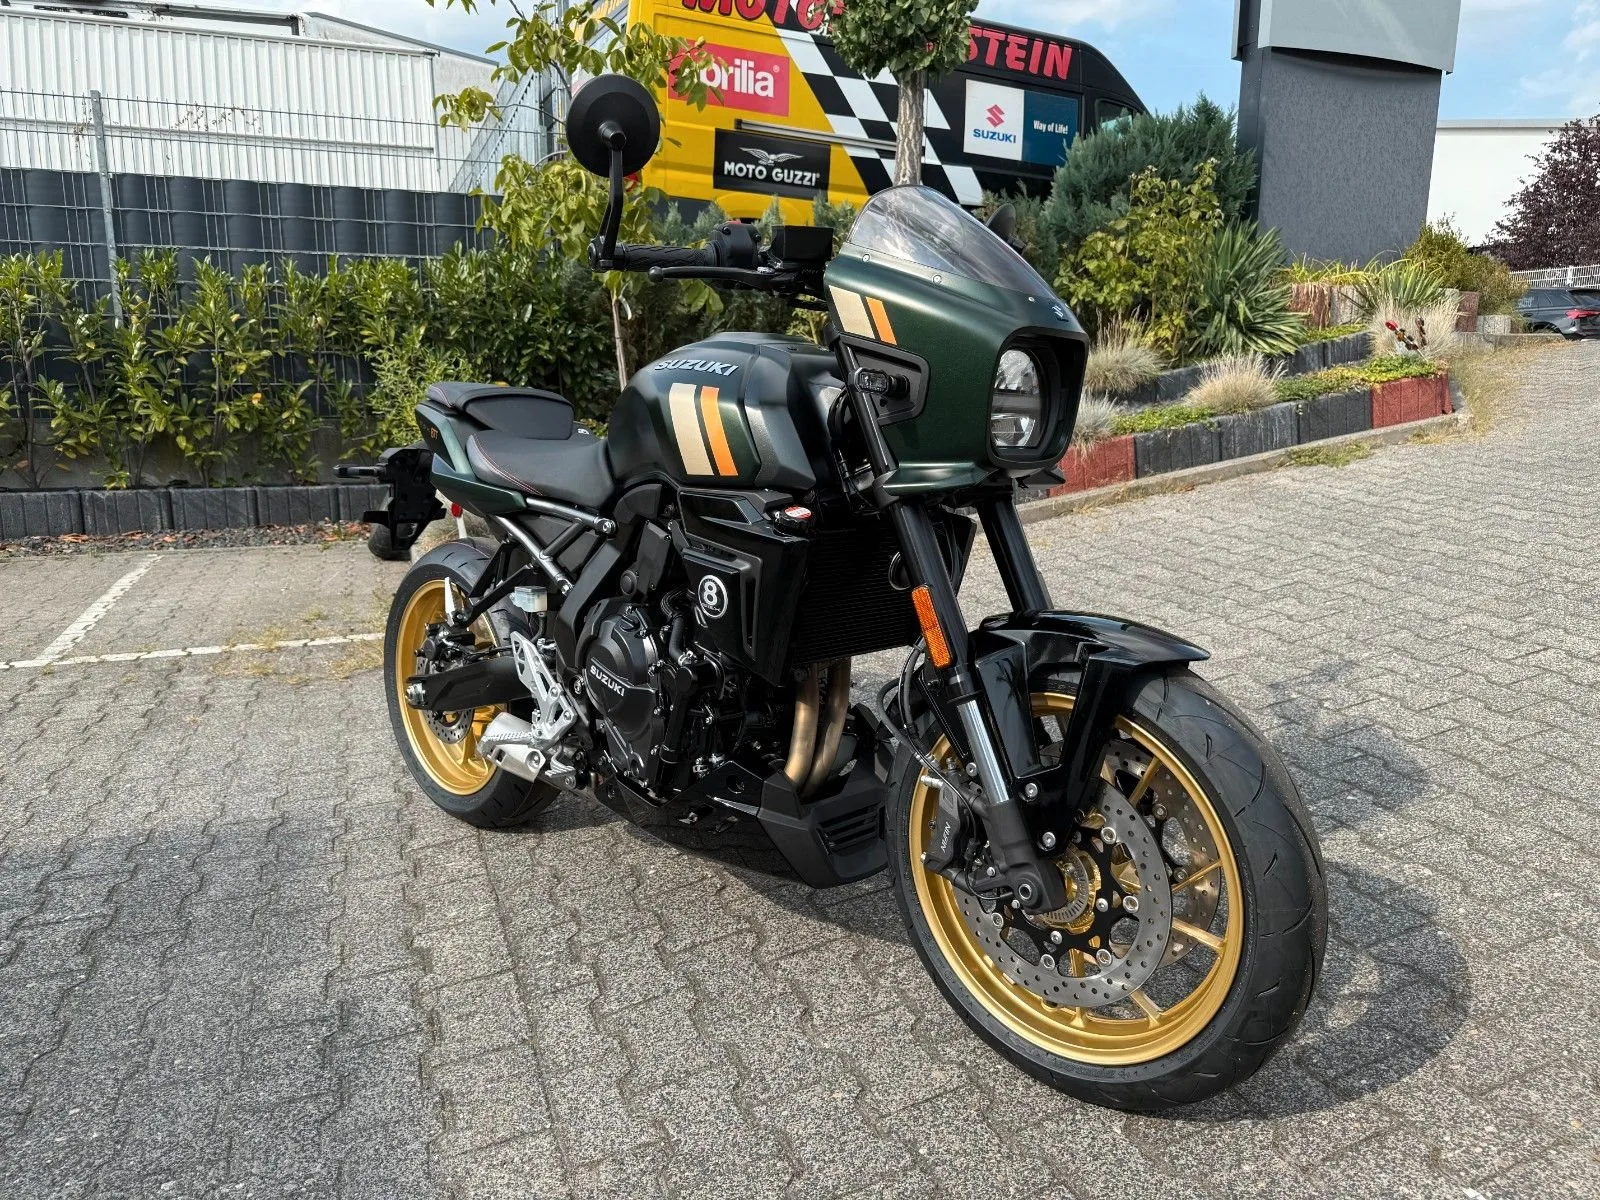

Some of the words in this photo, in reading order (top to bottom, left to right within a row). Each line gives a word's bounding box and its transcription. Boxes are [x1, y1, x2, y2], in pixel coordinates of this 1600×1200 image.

[682, 58, 774, 98] prilia
[973, 128, 1017, 144] SUZUKI
[1033, 120, 1047, 133] Way
[1047, 123, 1055, 133] of
[1055, 123, 1069, 135] Life!
[723, 160, 767, 180] MOTO
[772, 168, 816, 187] GUZZI
[655, 359, 739, 377] SUZUKI
[703, 581, 718, 606] 8
[590, 664, 625, 697] SUZUKI
